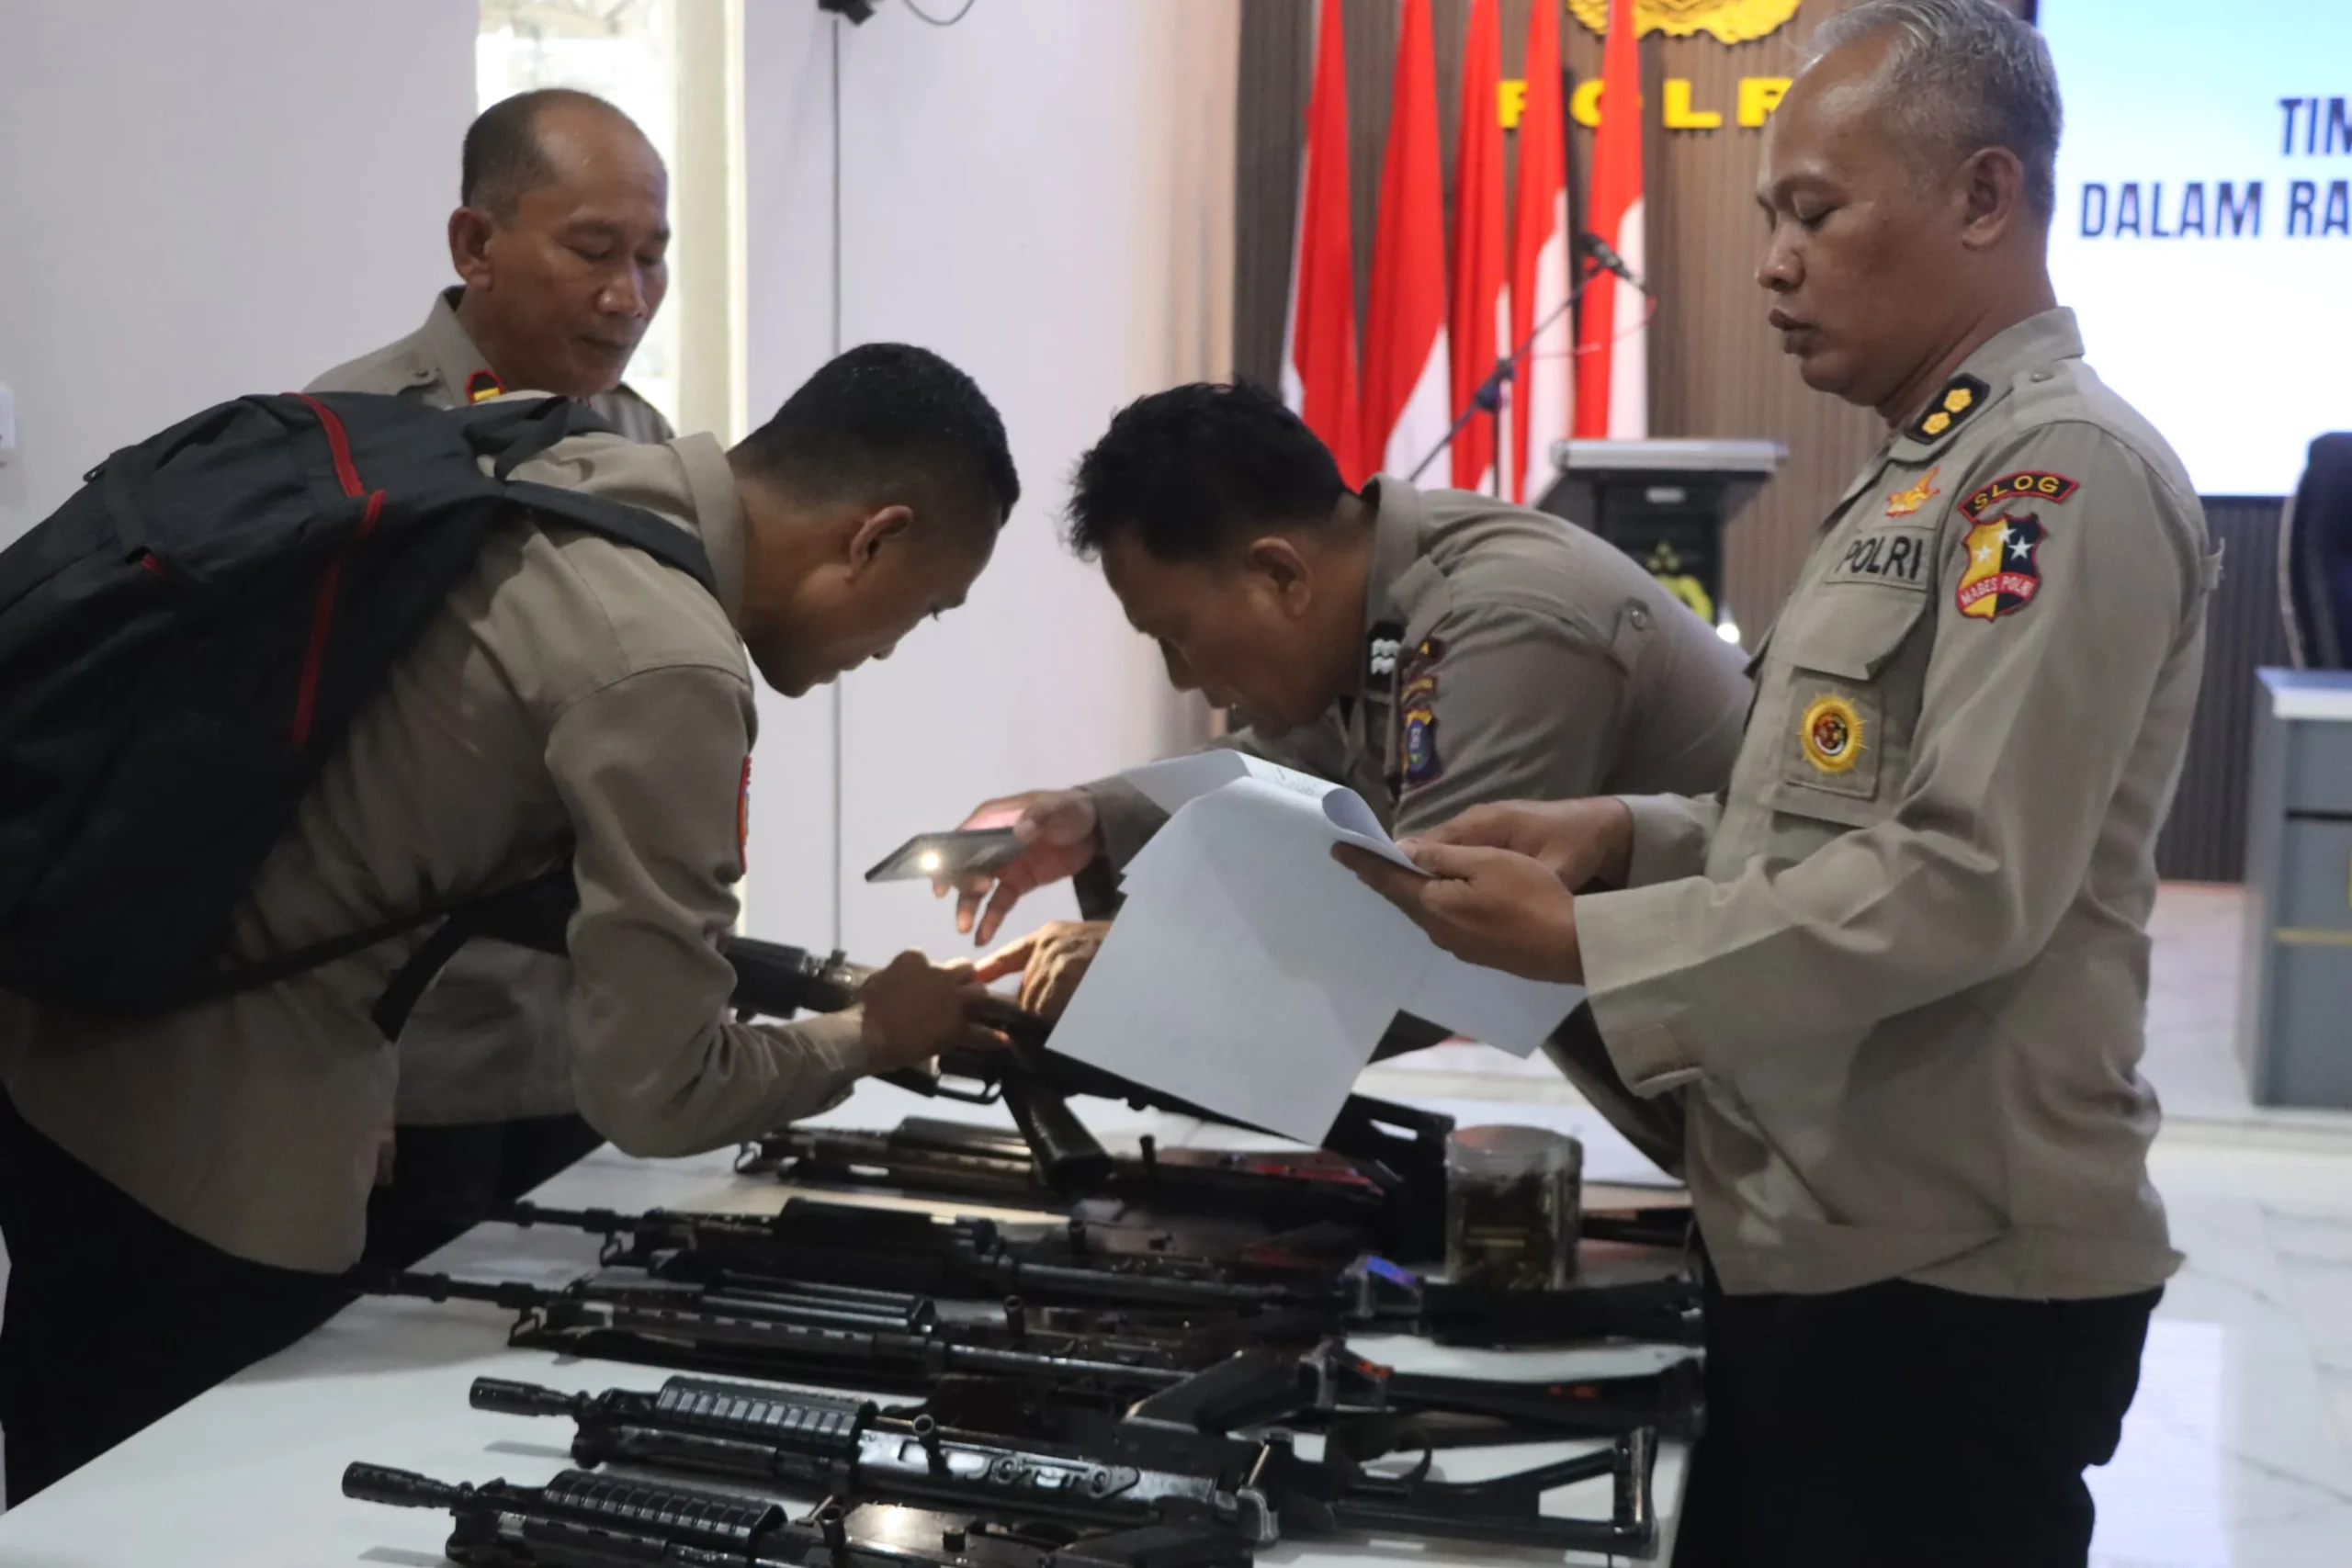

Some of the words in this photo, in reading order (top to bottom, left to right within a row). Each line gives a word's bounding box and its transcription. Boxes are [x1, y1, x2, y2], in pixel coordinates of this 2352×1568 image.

[2080, 181, 2263, 237] DALAM
[2287, 180, 2349, 237] RA
[1974, 475, 2060, 509] SLOG
[1834, 536, 1923, 581] POLRI
